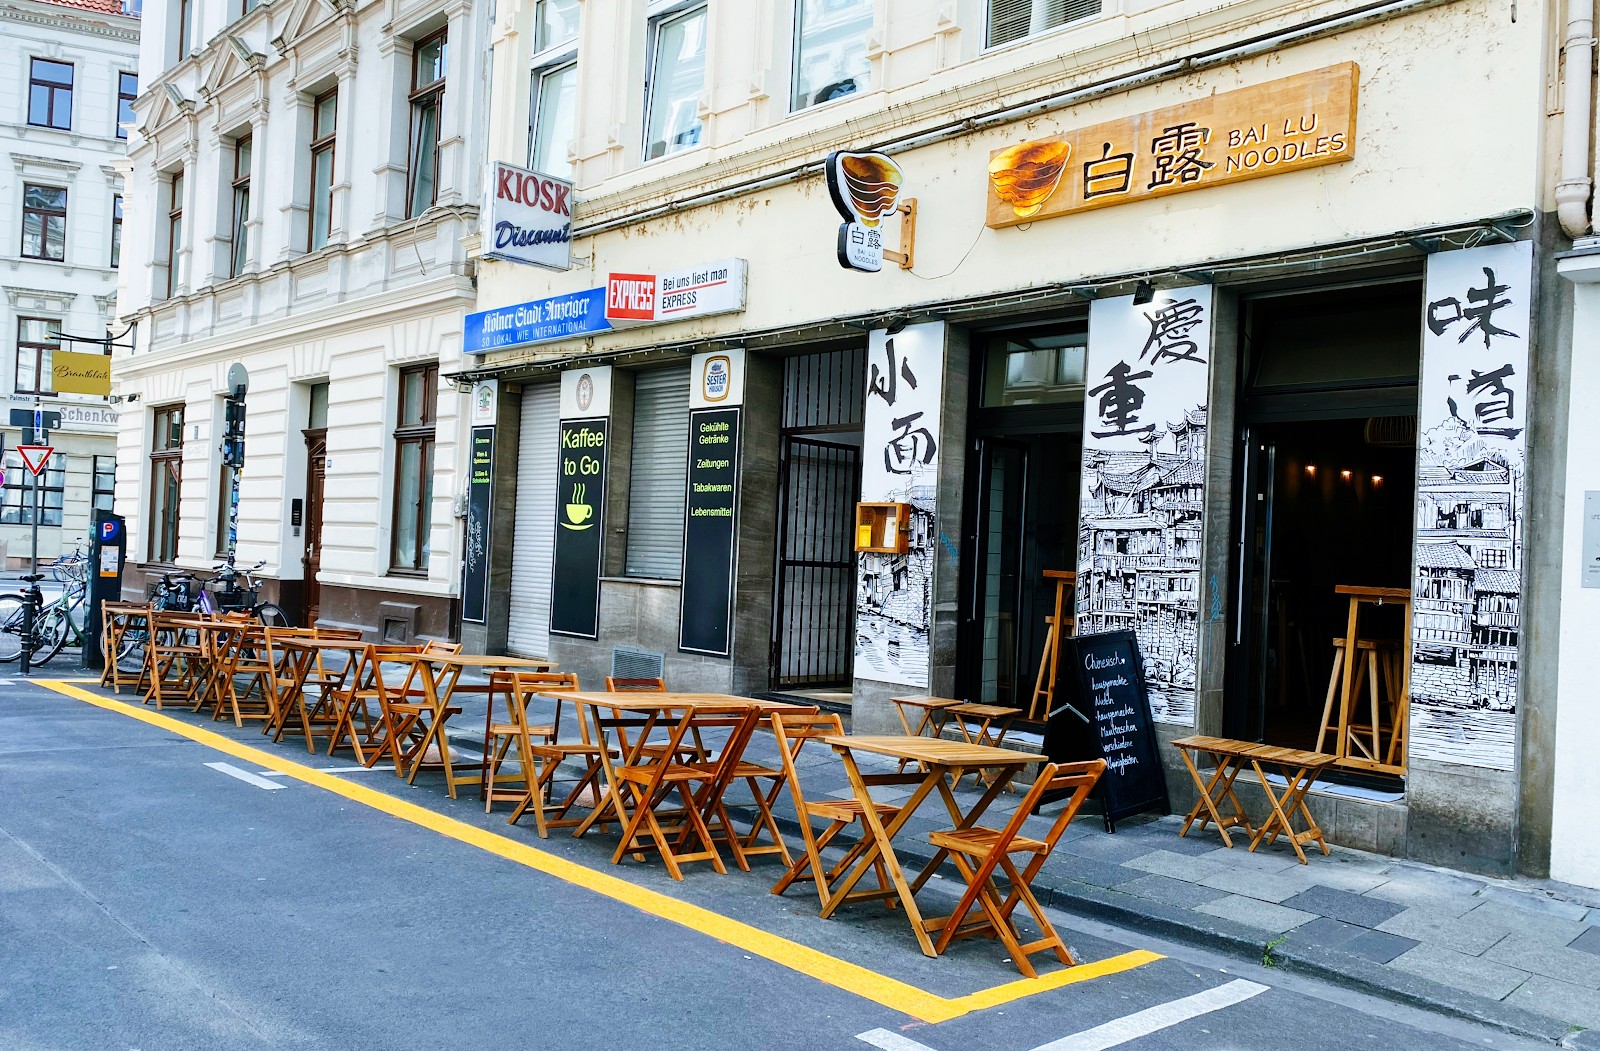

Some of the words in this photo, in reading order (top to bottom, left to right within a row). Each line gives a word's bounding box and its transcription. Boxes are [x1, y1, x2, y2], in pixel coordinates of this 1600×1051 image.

[1228, 123, 1268, 148] BAI
[1283, 113, 1319, 137] LU
[1083, 122, 1217, 200] 白露
[1226, 133, 1347, 173] NOODLES
[497, 167, 571, 217] KIOSK
[495, 220, 571, 249] Discount
[854, 254, 878, 266] NOODLES
[663, 276, 675, 291] Bei
[676, 276, 690, 288] uns
[692, 270, 709, 286] liest
[710, 268, 728, 282] man
[609, 279, 654, 311] EXPRESS
[662, 290, 697, 309] EXPRESS
[481, 311, 514, 334] Kölner
[481, 337, 490, 348] SO
[493, 332, 513, 346] LOKAL
[516, 331, 529, 342] WIE
[532, 319, 588, 339] INTERNATIONAL
[706, 373, 727, 386] SESTER
[867, 337, 937, 475] 小面
[562, 427, 605, 449] Kaffee
[699, 422, 730, 433] Gekühlte
[698, 434, 730, 445] Getränke
[563, 457, 577, 476] to
[579, 455, 600, 476] Go
[696, 459, 730, 470] Zeitungen
[692, 482, 732, 493] Tabakwaren
[690, 506, 732, 517] Lebensmittel
[1085, 651, 1122, 670] Chinesisch
